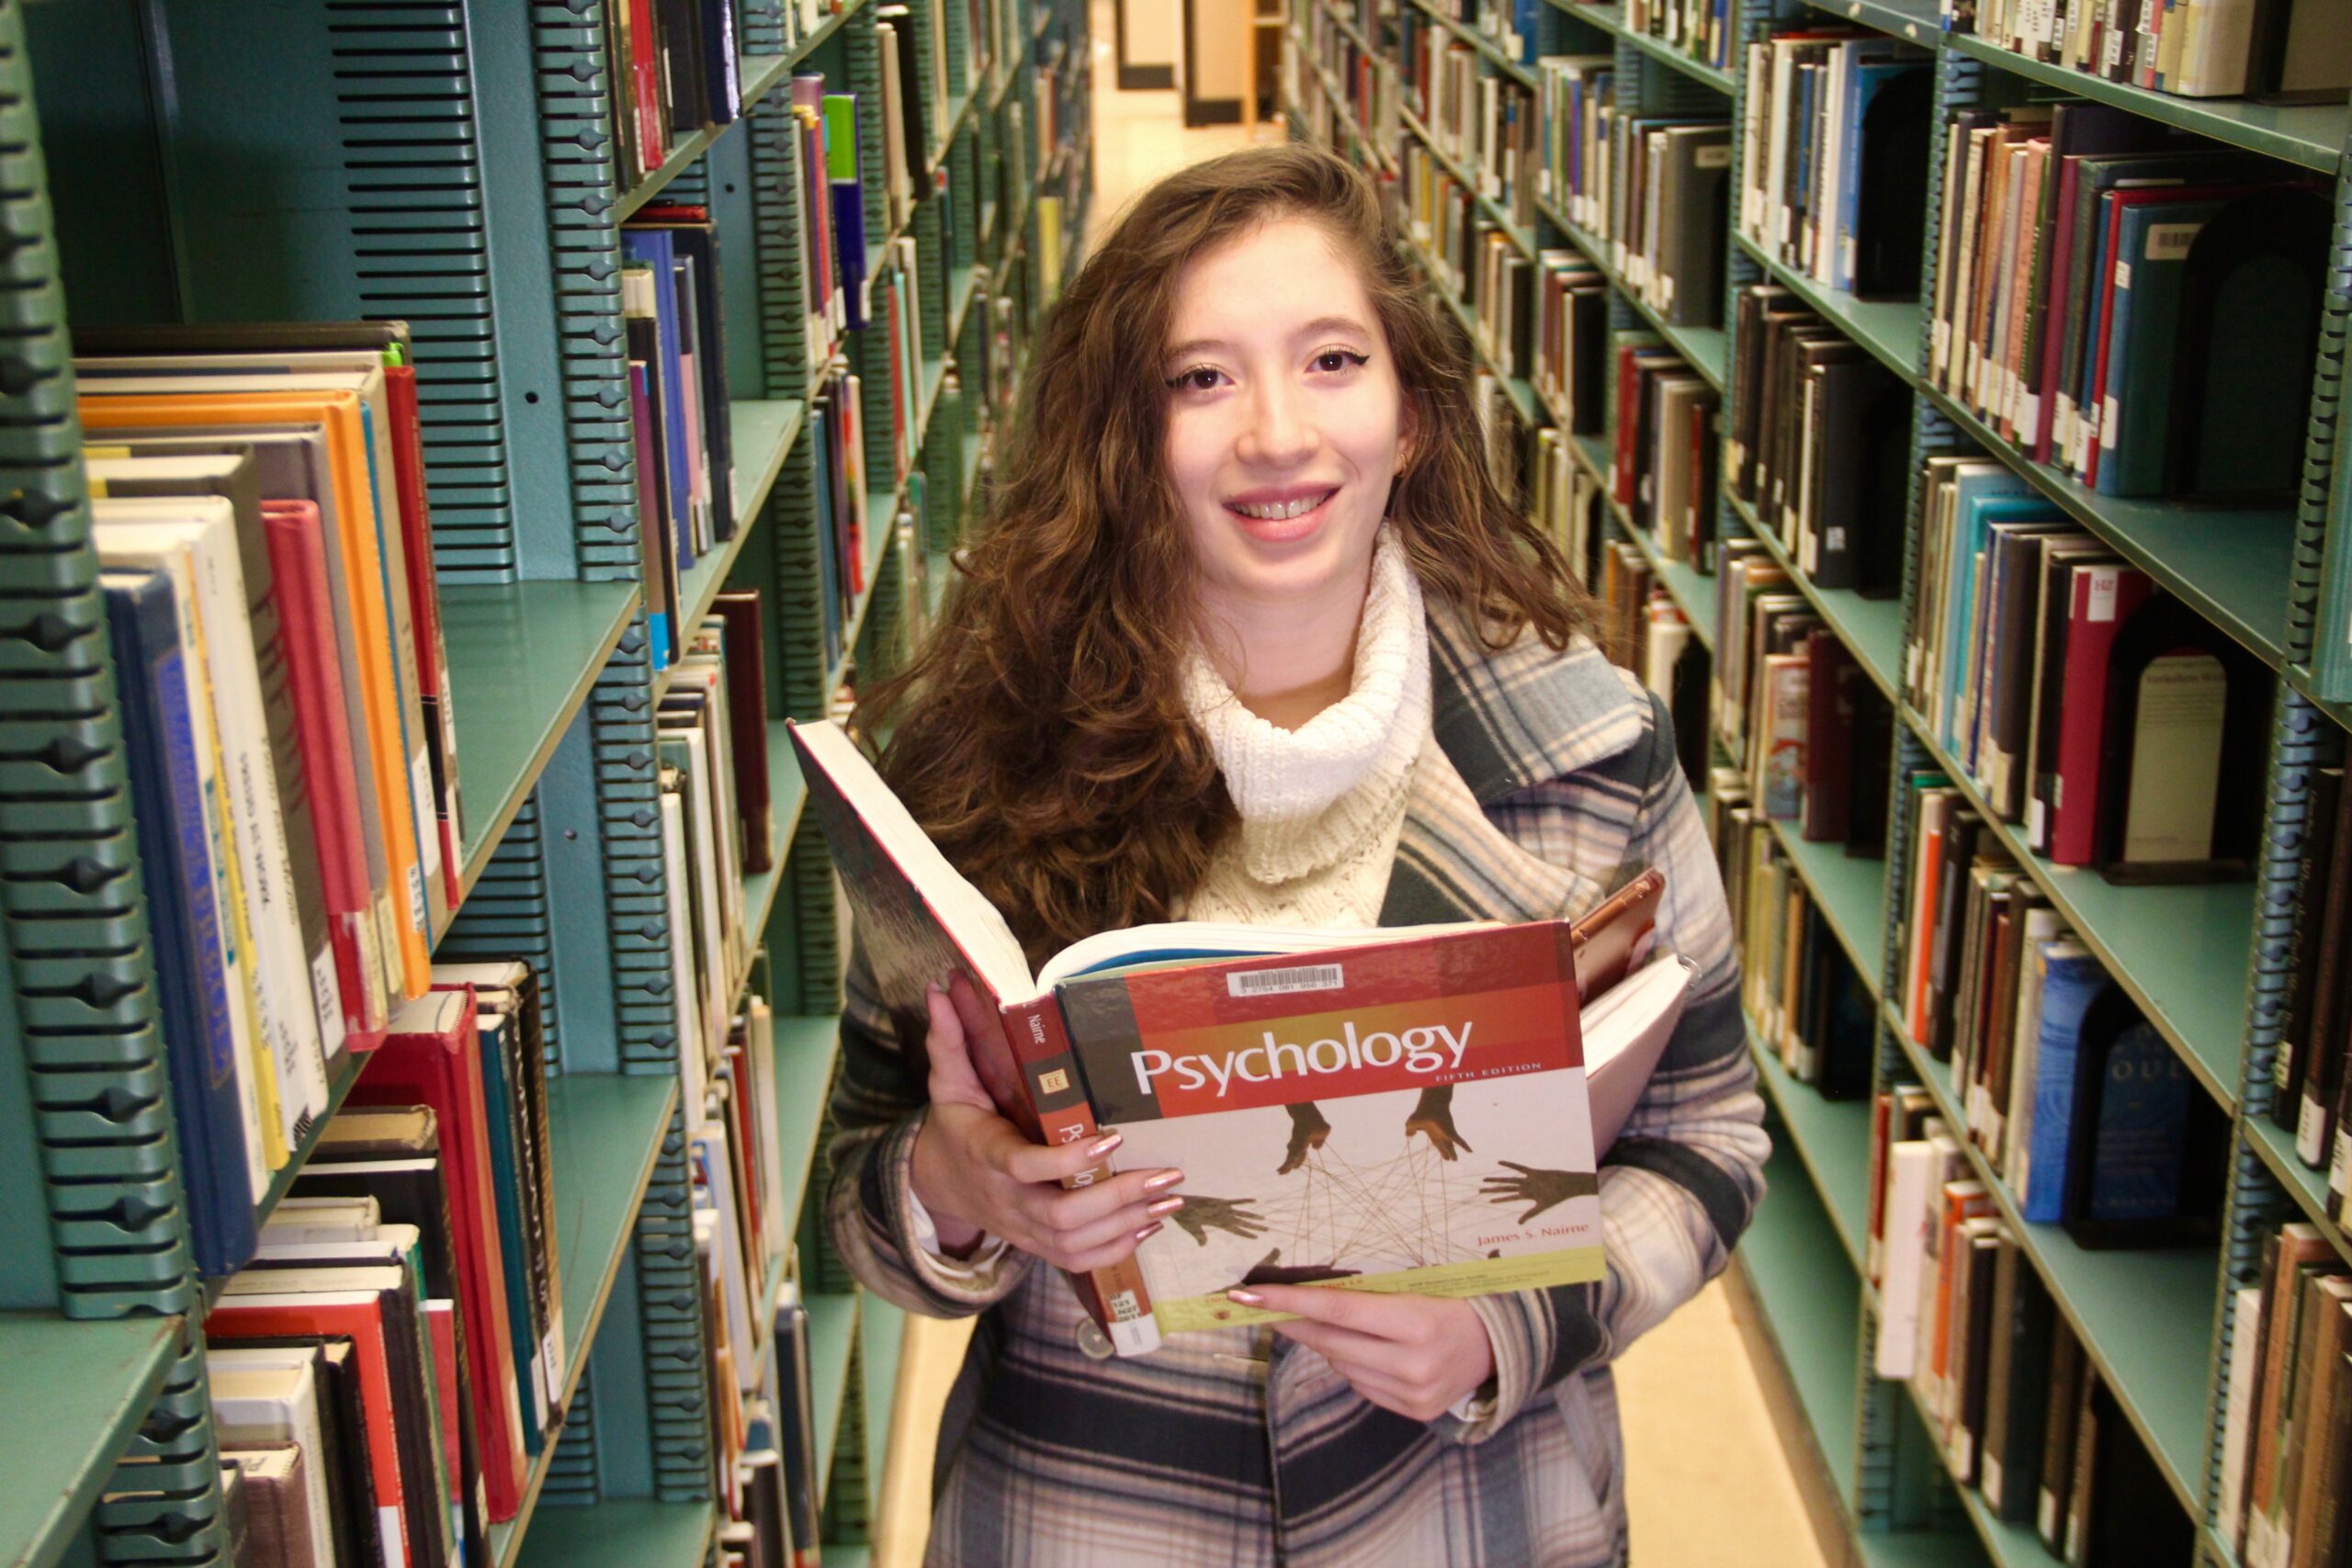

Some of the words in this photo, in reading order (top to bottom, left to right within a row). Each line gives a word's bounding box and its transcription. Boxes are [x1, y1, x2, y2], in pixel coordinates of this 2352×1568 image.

[1028, 1013, 1046, 1044] Nairne
[1130, 1021, 1473, 1098] Psychology
[1046, 1075, 1062, 1089] EE
[1435, 1070, 1475, 1082] FIFTH
[1481, 1062, 1542, 1077] EDITION
[1477, 1233, 1521, 1247] James
[1524, 1229, 1536, 1239] S.
[1541, 1223, 1589, 1237] Nairne
